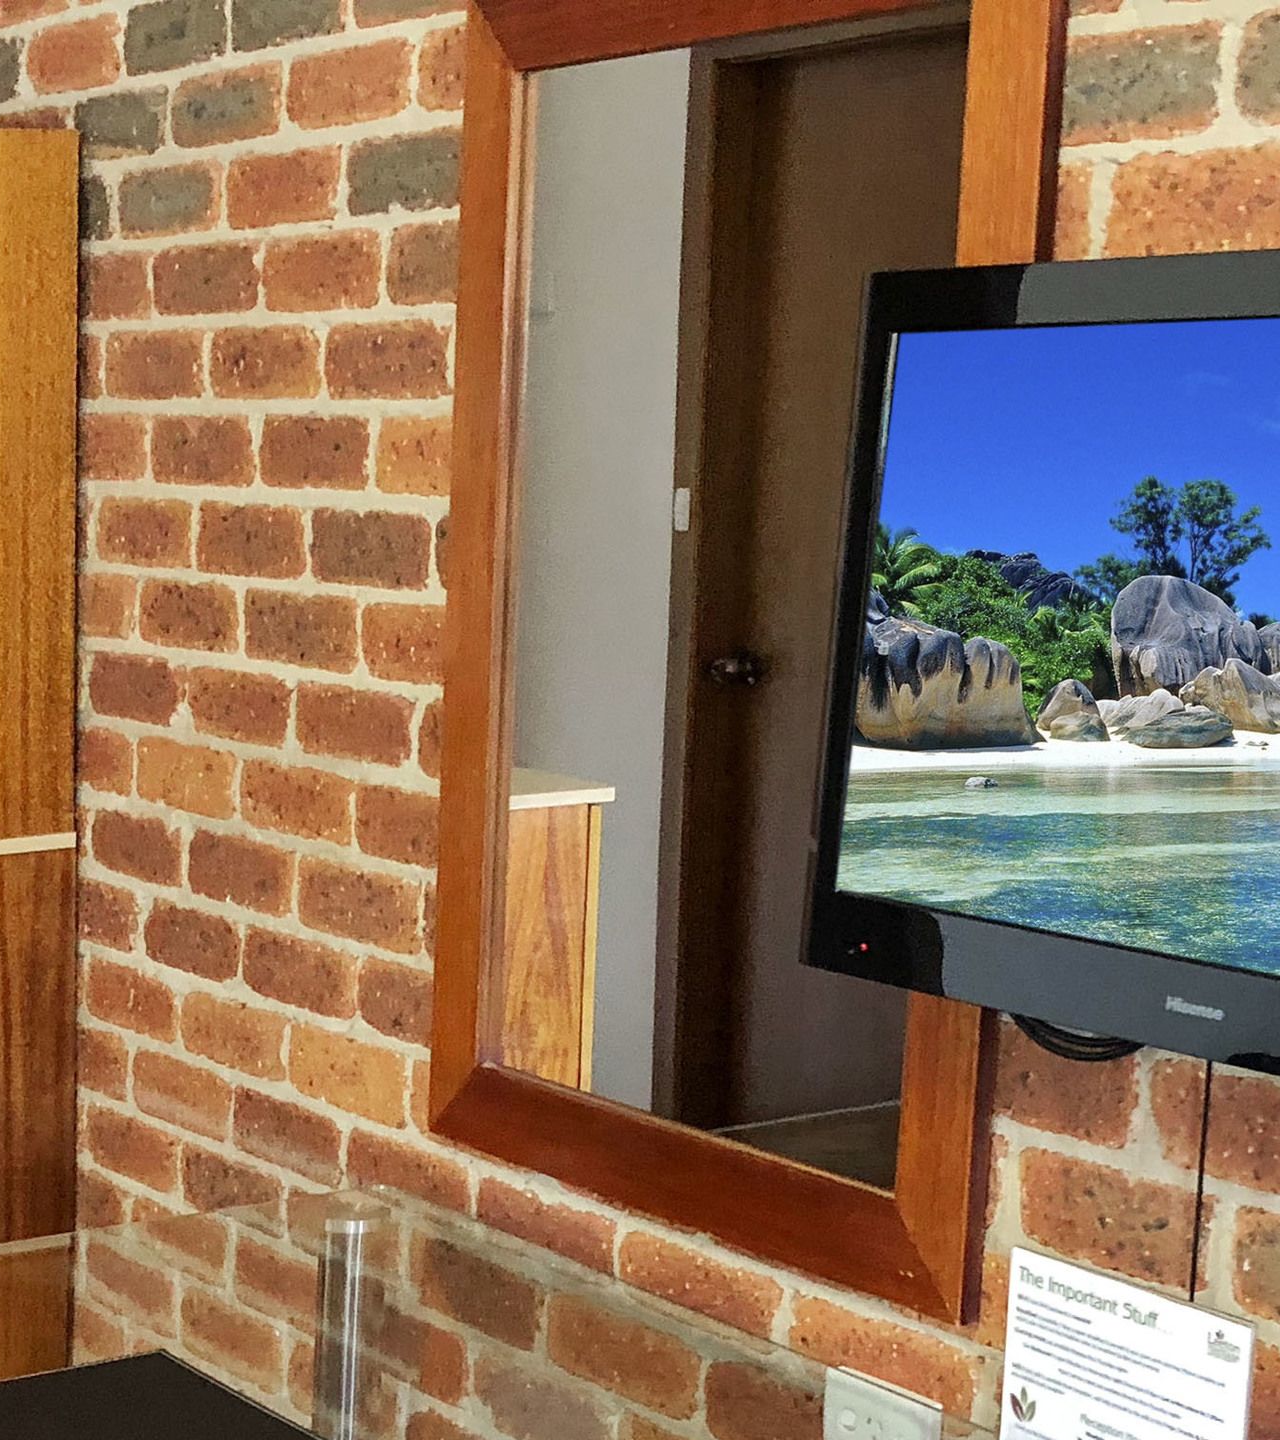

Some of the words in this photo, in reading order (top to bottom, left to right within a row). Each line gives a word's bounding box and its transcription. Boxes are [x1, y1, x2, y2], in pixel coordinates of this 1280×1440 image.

[1165, 995, 1226, 1021] Hisense
[1019, 1265, 1044, 1289] The
[1047, 1276, 1119, 1316] Important
